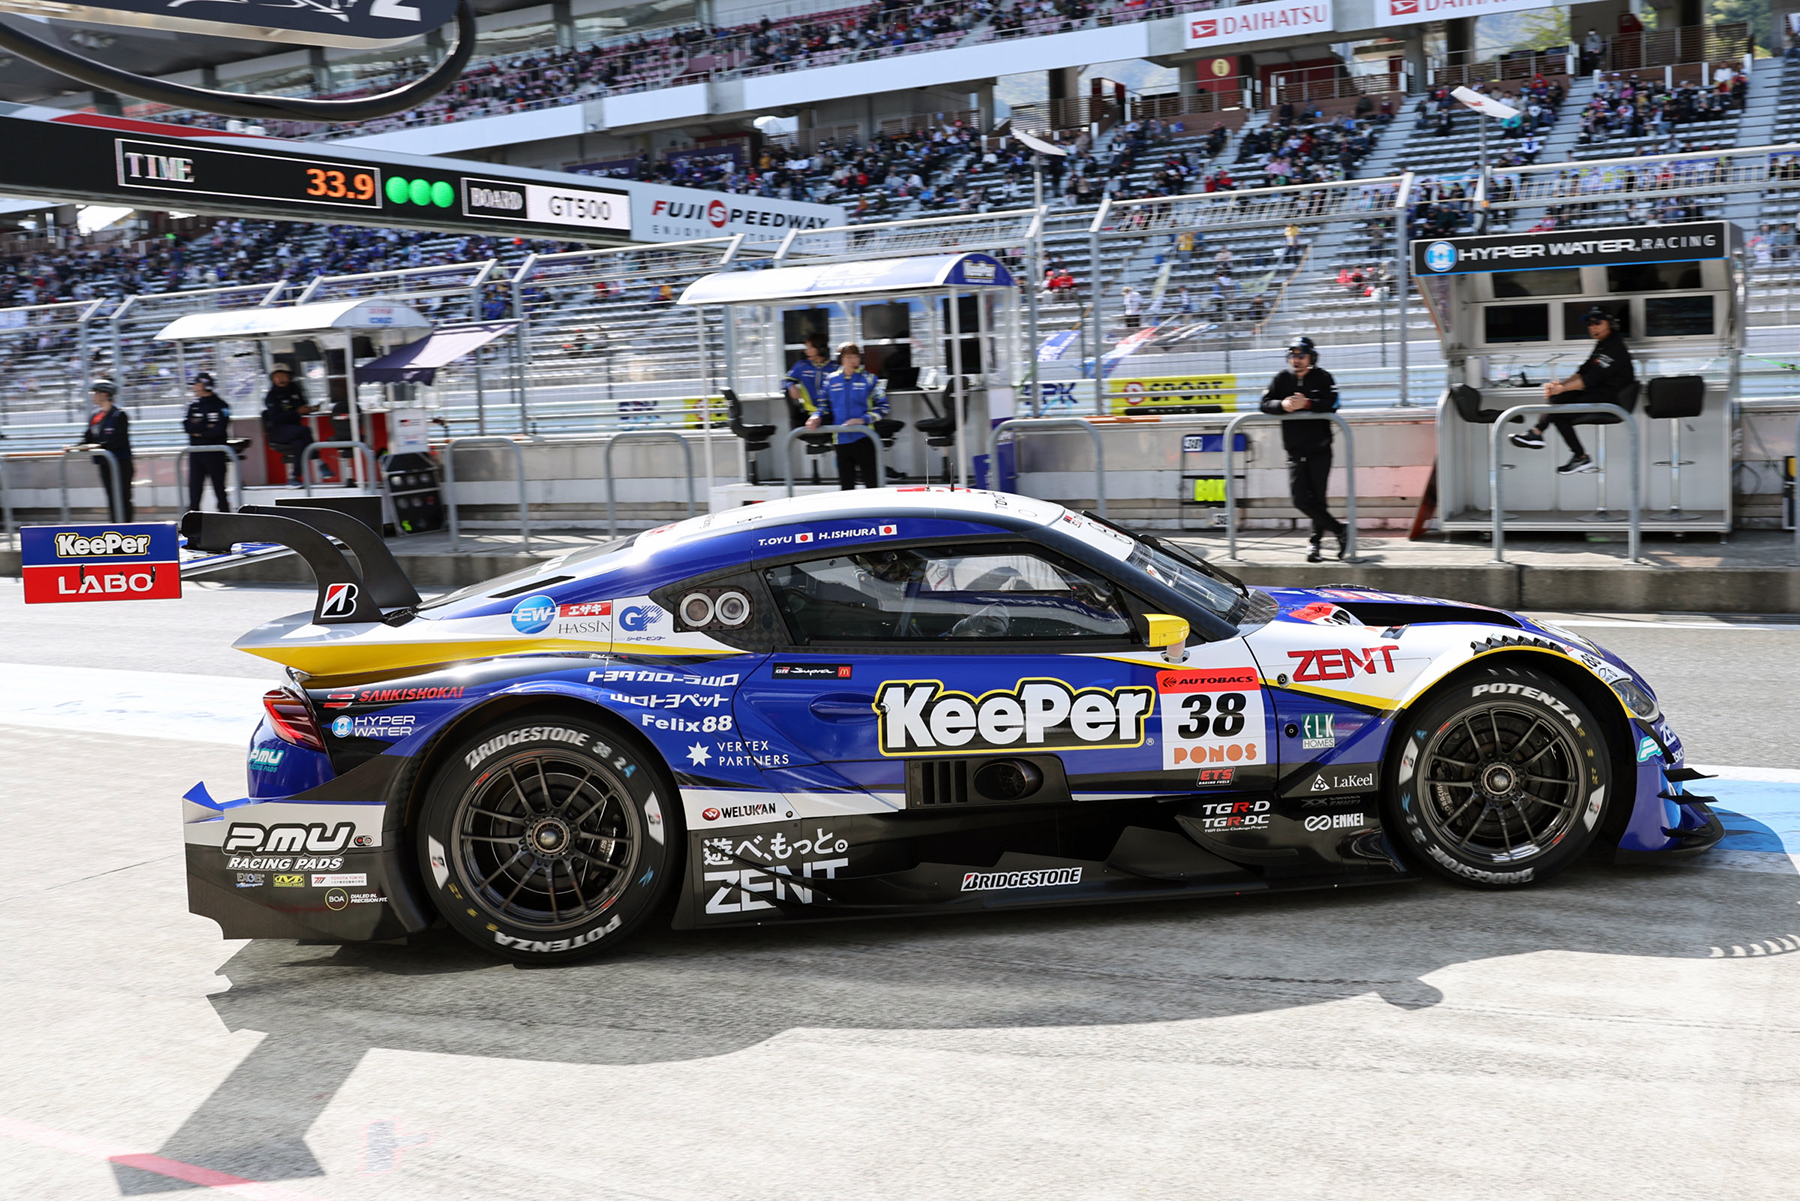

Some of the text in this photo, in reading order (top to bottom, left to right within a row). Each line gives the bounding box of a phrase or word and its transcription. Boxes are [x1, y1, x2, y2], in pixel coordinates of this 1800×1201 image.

[1223, 4, 1328, 35] DAIHATSU
[124, 152, 195, 183] TIME
[306, 168, 375, 200] 33.9
[469, 187, 523, 211] BOARD
[550, 195, 612, 221] GT500
[651, 199, 704, 221] FUJI
[1458, 243, 1546, 261] HYPER
[1642, 234, 1717, 250] RACING
[57, 532, 150, 556] KeePer
[758, 527, 877, 546] T.OYU H.ISHIURA
[58, 573, 154, 595] LABO
[515, 607, 552, 622] EW
[568, 604, 603, 616] エザキ
[790, 667, 835, 677] Supra
[1287, 645, 1399, 682] ZENT
[587, 670, 739, 687] トヨタカローラ山口
[1178, 674, 1254, 686] AUTOBACS
[358, 686, 465, 702] SANKISHOKAI
[609, 693, 730, 709] 山口トヨペット
[882, 683, 1147, 748] KeePer
[1177, 692, 1247, 740] 38
[1472, 683, 1582, 729] POTENZA
[354, 715, 416, 726] HYPER
[642, 713, 733, 732] Felix88
[1303, 714, 1334, 738] ELK
[354, 726, 413, 737] WATER
[464, 727, 590, 771] BRIDGESTONE
[717, 740, 769, 752] VERTEX
[1173, 742, 1257, 765] PONOS
[1303, 740, 1334, 748] HOMES
[719, 754, 790, 767] PARTNERS
[1200, 769, 1233, 781] ETS
[1334, 773, 1373, 788] LaKeel
[1202, 800, 1271, 815] TGR-D
[1202, 814, 1271, 828] TGR-DC
[1333, 813, 1364, 829] ENKEI
[703, 828, 849, 866] 遊べ、もっと。
[228, 856, 343, 870] RACING PADS
[704, 858, 849, 914] ZENT
[961, 867, 1082, 891] BRIDGESTONE
[494, 914, 623, 952] POTENZA
